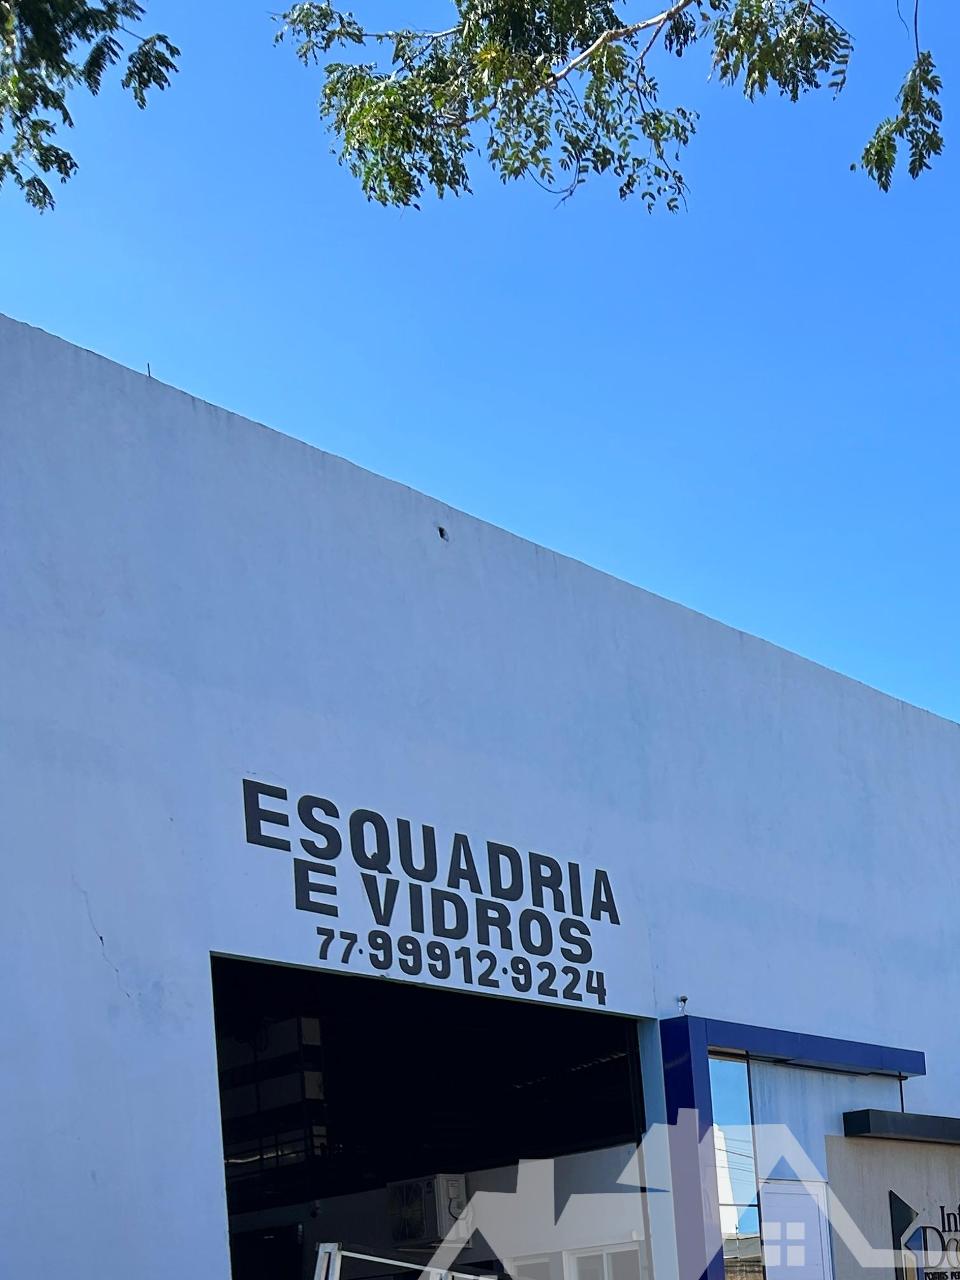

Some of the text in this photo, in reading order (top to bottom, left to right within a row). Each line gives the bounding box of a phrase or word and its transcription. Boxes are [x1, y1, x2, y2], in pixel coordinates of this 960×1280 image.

[242, 778, 621, 926] ESQUADRIA
[294, 858, 593, 964] E VIDROS
